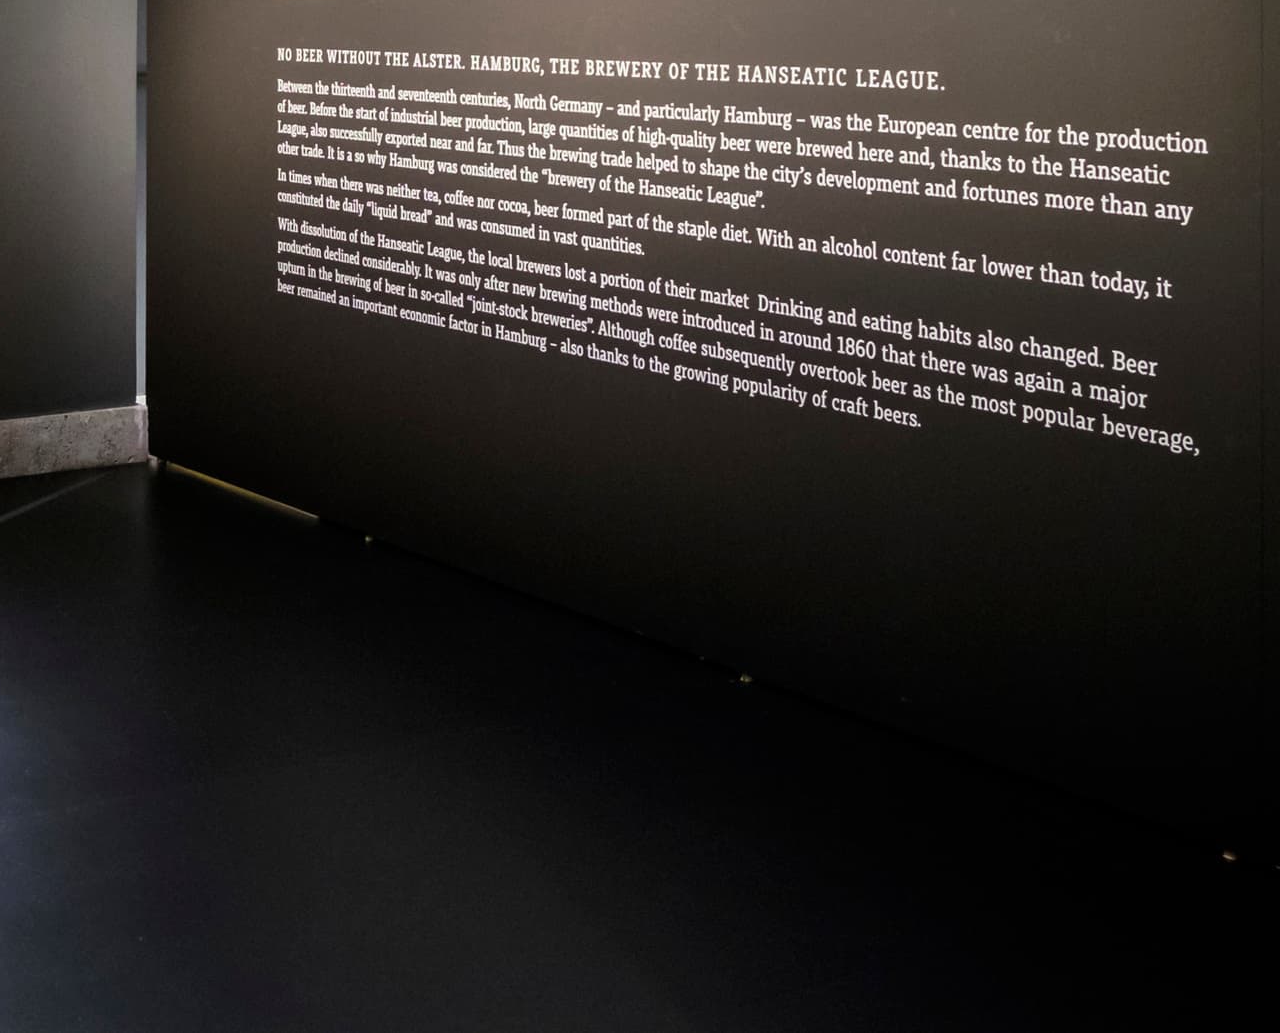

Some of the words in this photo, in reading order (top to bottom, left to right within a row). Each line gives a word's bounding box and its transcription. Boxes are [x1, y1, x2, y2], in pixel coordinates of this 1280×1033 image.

[276, 47, 292, 62] NO
[295, 47, 324, 63] BEER
[326, 48, 381, 66] WITHOUT
[384, 50, 410, 67] THE
[412, 52, 466, 70] ALSTER.
[470, 54, 544, 77] HAMBURG,
[548, 57, 580, 75] THE
[584, 58, 663, 79] BREWERY
[668, 62, 690, 80] OF
[694, 63, 730, 82] THE
[736, 64, 847, 87] HANSEATIC
[855, 67, 945, 91] LEAGUE.
[276, 77, 314, 95] Between
[314, 79, 330, 96] the
[330, 80, 376, 99] thirteenth
[377, 84, 396, 100] and
[397, 87, 458, 104] seventeenth
[458, 90, 512, 111] centuries,
[513, 92, 547, 111] North
[548, 94, 604, 119] Germany
[616, 98, 641, 117] and
[643, 101, 720, 126] particularly
[723, 104, 792, 131] Hamburg
[809, 114, 842, 130] was
[846, 112, 872, 132] the
[877, 113, 957, 140] European
[962, 122, 1019, 142] centre
[1024, 120, 1052, 144] for
[1057, 123, 1090, 147] the
[1095, 127, 1208, 154] production
[276, 190, 324, 208] constituted
[325, 194, 340, 211] the
[342, 196, 364, 217] daily
[434, 211, 454, 228] and
[456, 217, 478, 231] was
[480, 220, 536, 240] consumed
[538, 224, 550, 242] in
[552, 230, 578, 246] vast
[580, 234, 644, 256] quantities.
[276, 260, 306, 277] upturn
[307, 263, 316, 279] in
[318, 265, 333, 282] the
[334, 267, 372, 293] brewing
[372, 276, 382, 292] of
[384, 277, 406, 297] beer
[408, 282, 418, 300] in
[420, 289, 464, 308] so-called
[466, 294, 528, 321] “joint-stock
[530, 305, 594, 334] breweries”.
[597, 319, 655, 348] Although
[658, 332, 697, 355] coffee
[700, 340, 795, 377] subsequently
[799, 362, 867, 388] overtook
[871, 369, 907, 396] beer
[912, 383, 932, 400] as
[936, 383, 965, 407] the
[970, 394, 1016, 417] most
[1022, 404, 1095, 432] popular
[1102, 412, 1198, 456] beverage,
